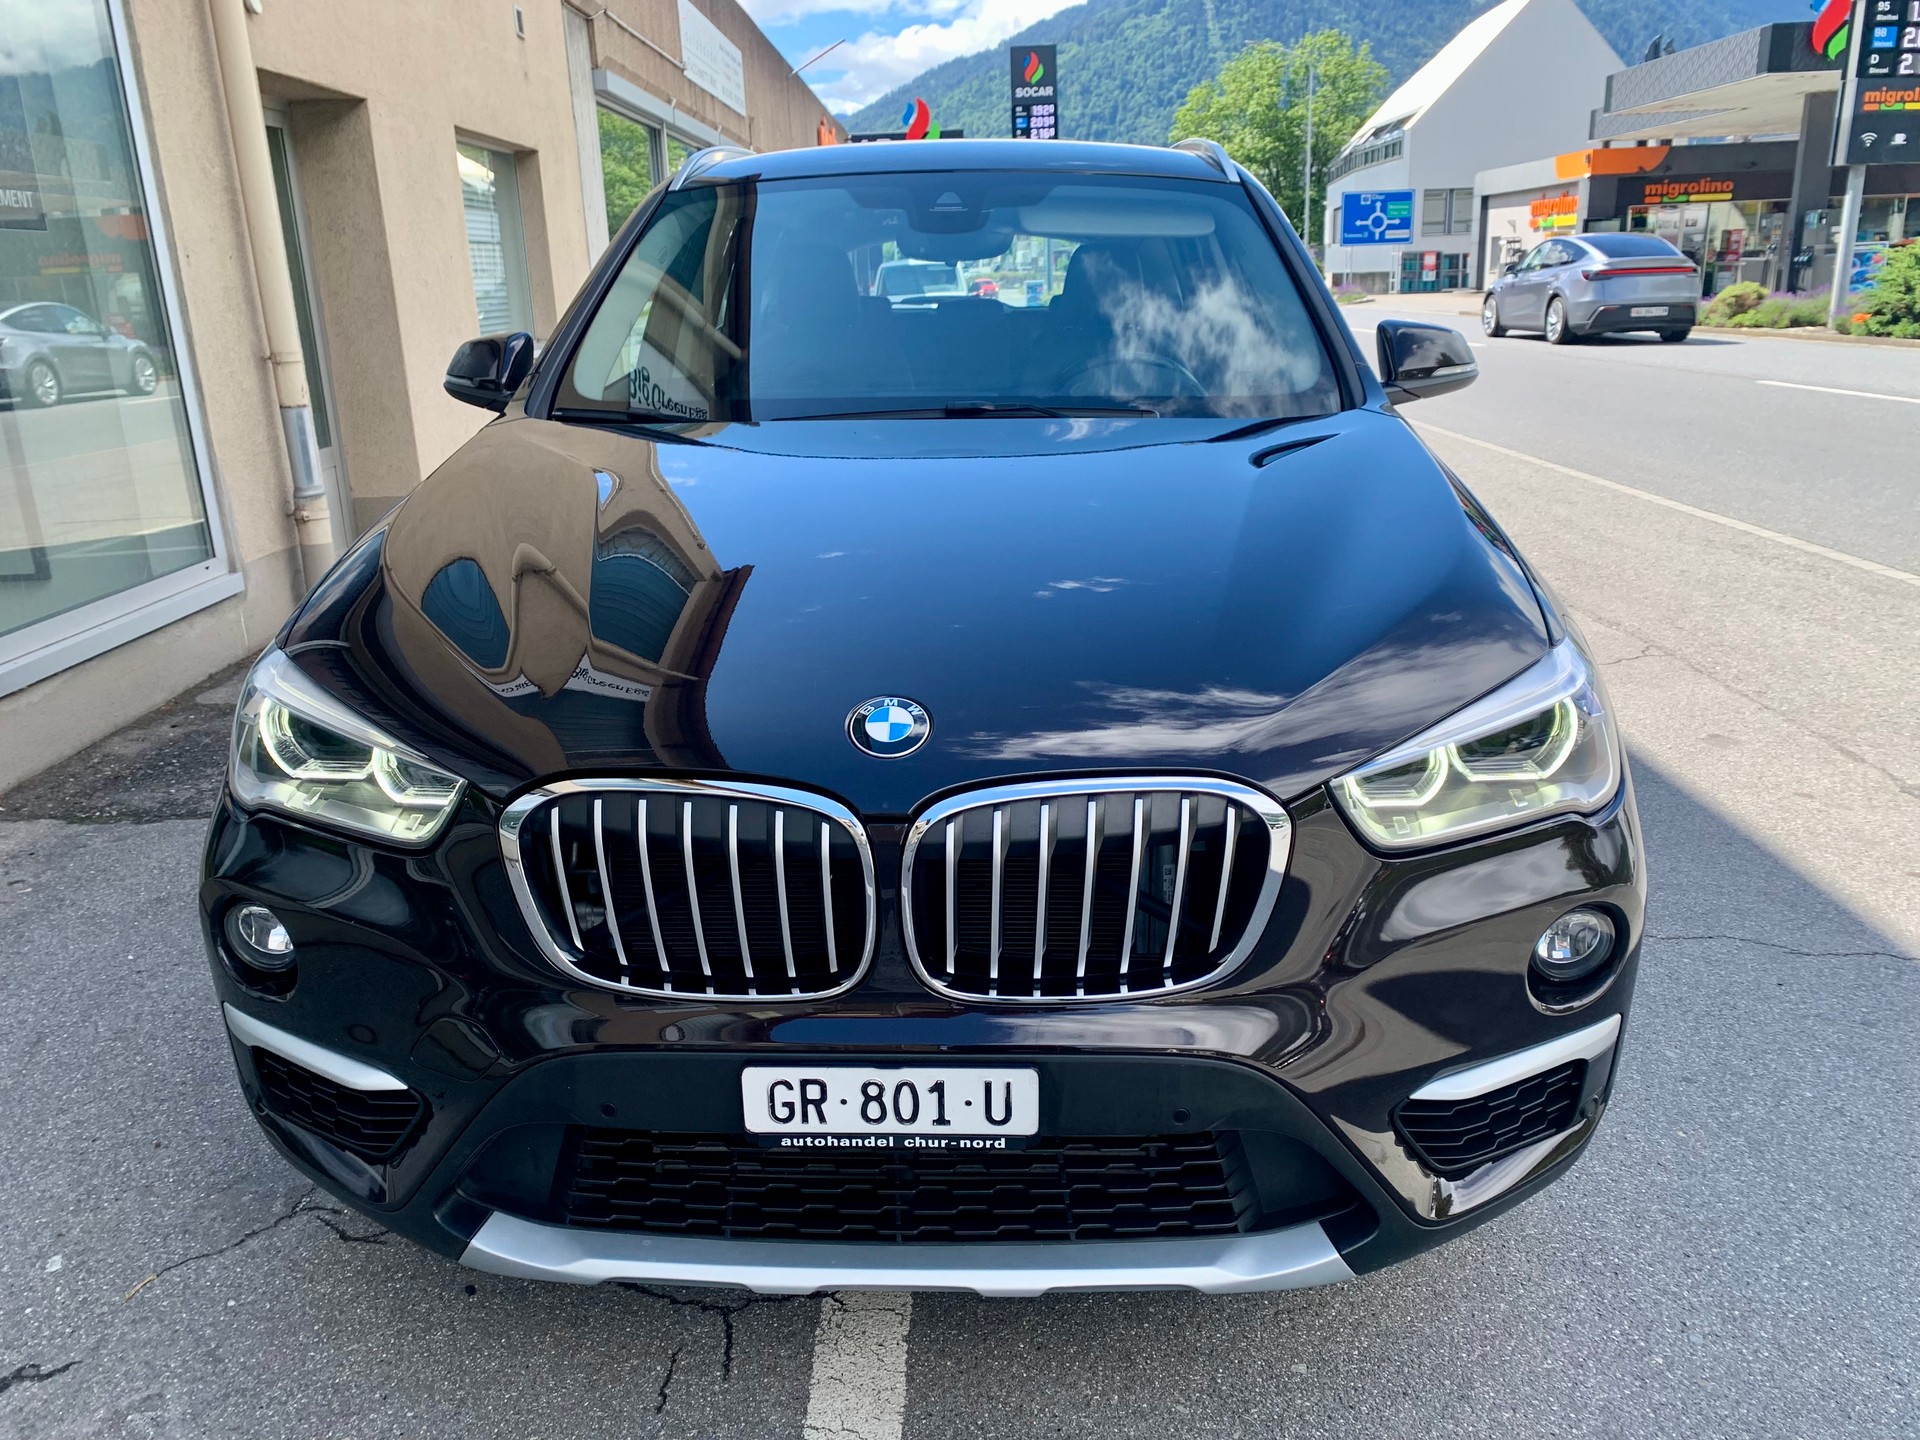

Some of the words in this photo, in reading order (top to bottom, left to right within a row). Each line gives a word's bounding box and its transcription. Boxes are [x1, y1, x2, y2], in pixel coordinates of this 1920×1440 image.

[1877, 1, 1891, 11] 95
[1873, 27, 1888, 38] 98
[1870, 54, 1880, 64] D
[1015, 86, 1054, 98] SOCAR
[1864, 86, 1920, 106] migrol
[1644, 177, 1734, 197] migrolino
[0, 189, 33, 208] MENT
[860, 698, 923, 716] BMW
[780, 1135, 894, 1148] autohandel
[904, 1136, 1006, 1149] chur-nord
